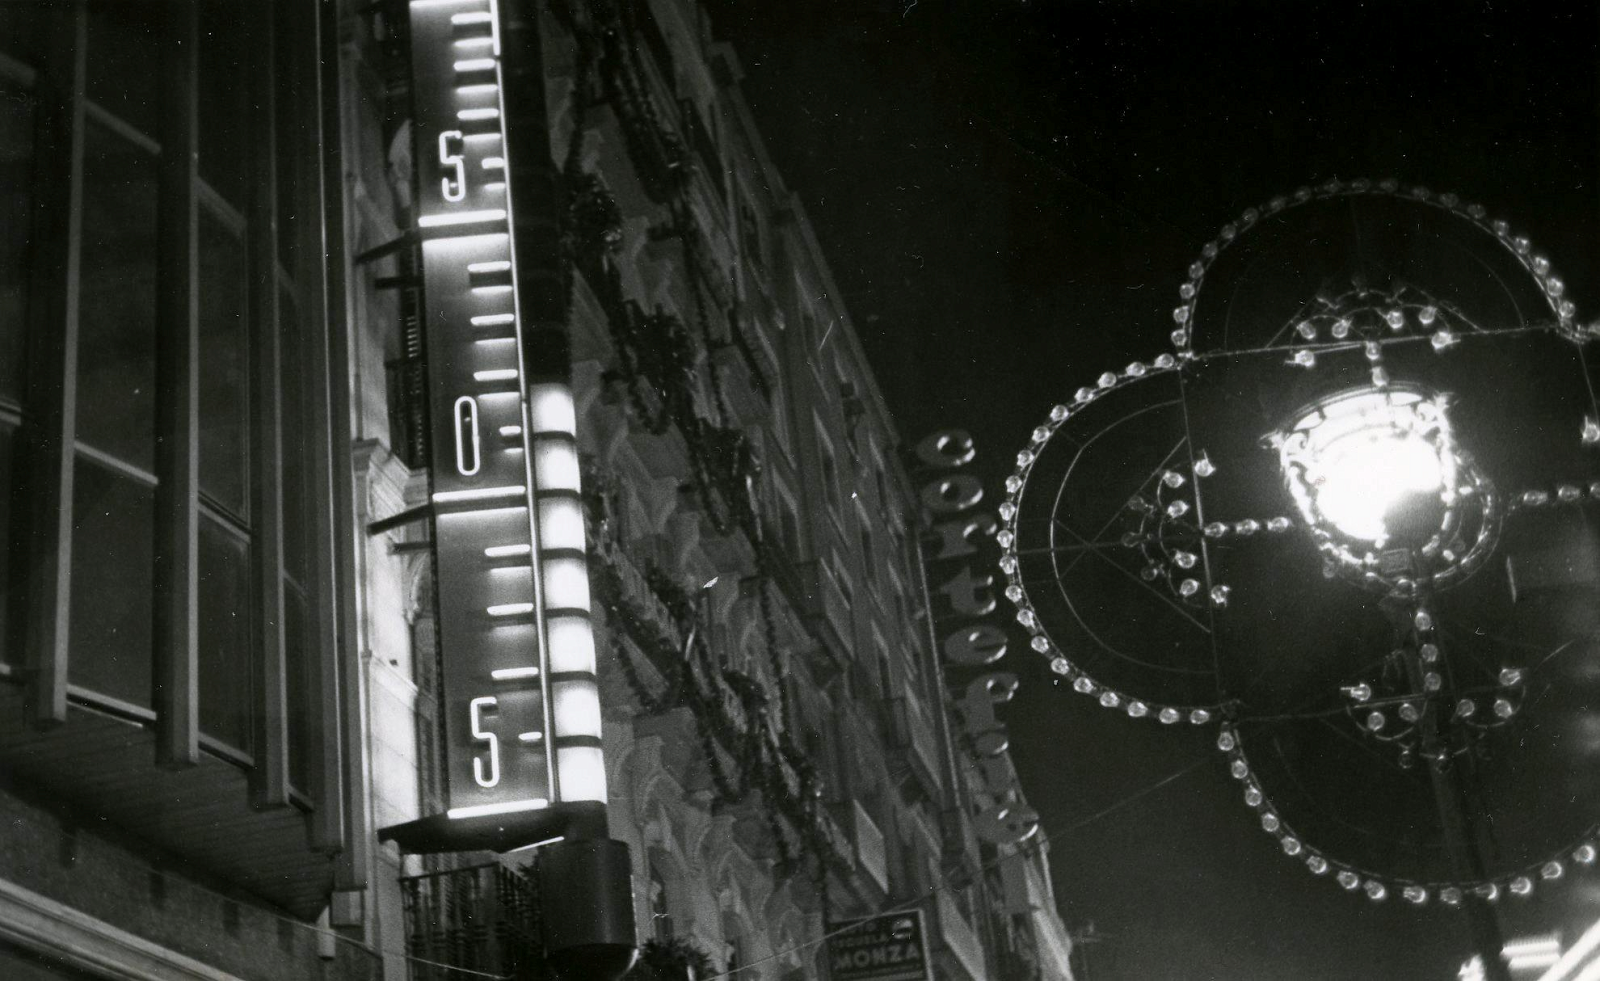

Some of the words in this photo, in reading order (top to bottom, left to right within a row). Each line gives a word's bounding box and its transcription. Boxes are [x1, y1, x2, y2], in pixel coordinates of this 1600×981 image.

[439, 130, 466, 202] 5
[470, 696, 500, 787] 5
[833, 942, 921, 970] MONZA
